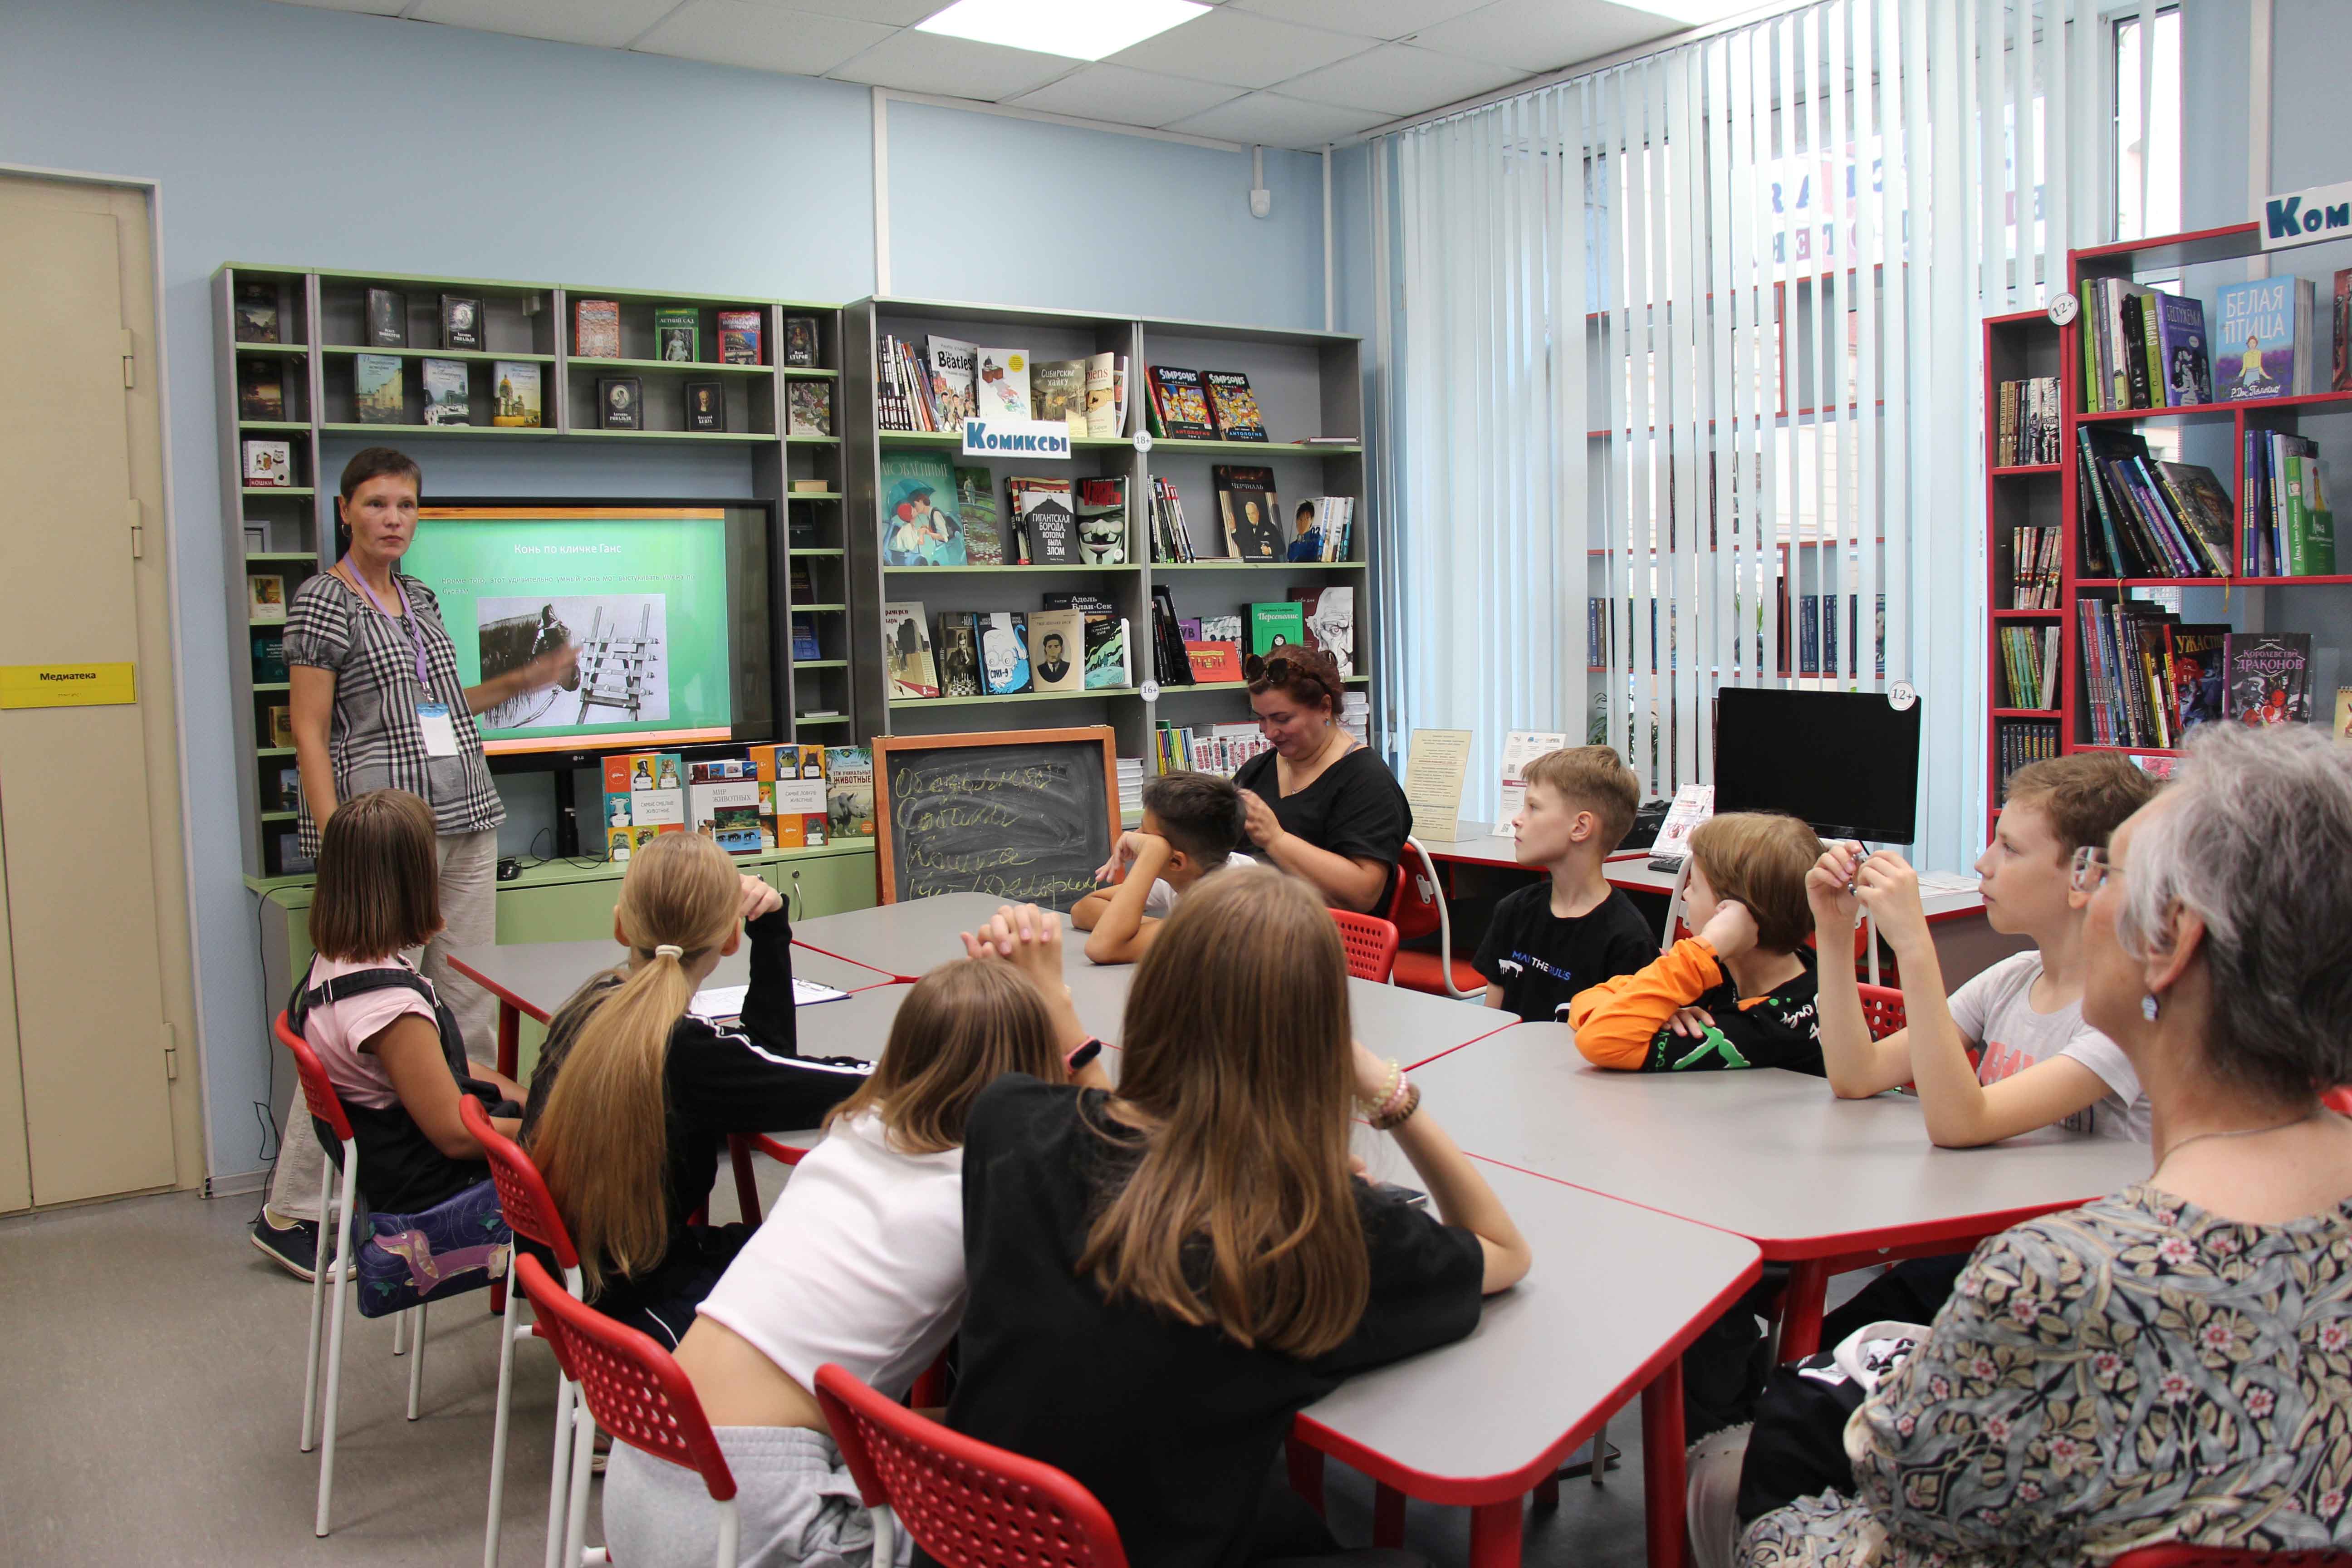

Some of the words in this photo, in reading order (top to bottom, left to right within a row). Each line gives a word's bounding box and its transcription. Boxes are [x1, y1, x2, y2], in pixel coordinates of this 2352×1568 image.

[2266, 196, 2352, 239] Ком
[2226, 285, 2284, 318] БЕЛАЯ
[2051, 301, 2074, 318] 12+
[2145, 310, 2158, 346] СУРВИЛО
[2225, 313, 2284, 344] ПТИЦА
[937, 351, 973, 371] Beatles
[1041, 369, 1075, 378] Сибирские
[1159, 368, 1196, 382] SIMPSONS
[1048, 378, 1068, 387] хайку
[1209, 373, 1245, 385] SIMPSONS
[967, 422, 1067, 452] Комиксы
[1136, 436, 1151, 445] 18+
[1231, 482, 1264, 490] ЧЕРЧИЛЛЬ
[1033, 514, 1070, 524] ГИГАНТСКАЯ
[1039, 522, 1066, 532] БОРОДА,
[514, 544, 541, 554] Конь
[544, 546, 558, 554] по
[560, 544, 597, 554] кличке
[598, 544, 622, 554] Ганс
[1047, 546, 1065, 556] ЗЛОМ
[443, 587, 469, 595] буквам
[1071, 596, 1098, 604] Адель
[1258, 612, 1298, 622] Персеполис
[2237, 659, 2303, 674] ДРАКОНОВ
[40, 672, 97, 681] Медиатека
[1143, 686, 1157, 694] 16+
[1890, 688, 1912, 702] 12+
[834, 775, 872, 784] ЖИВОТНЫЕ
